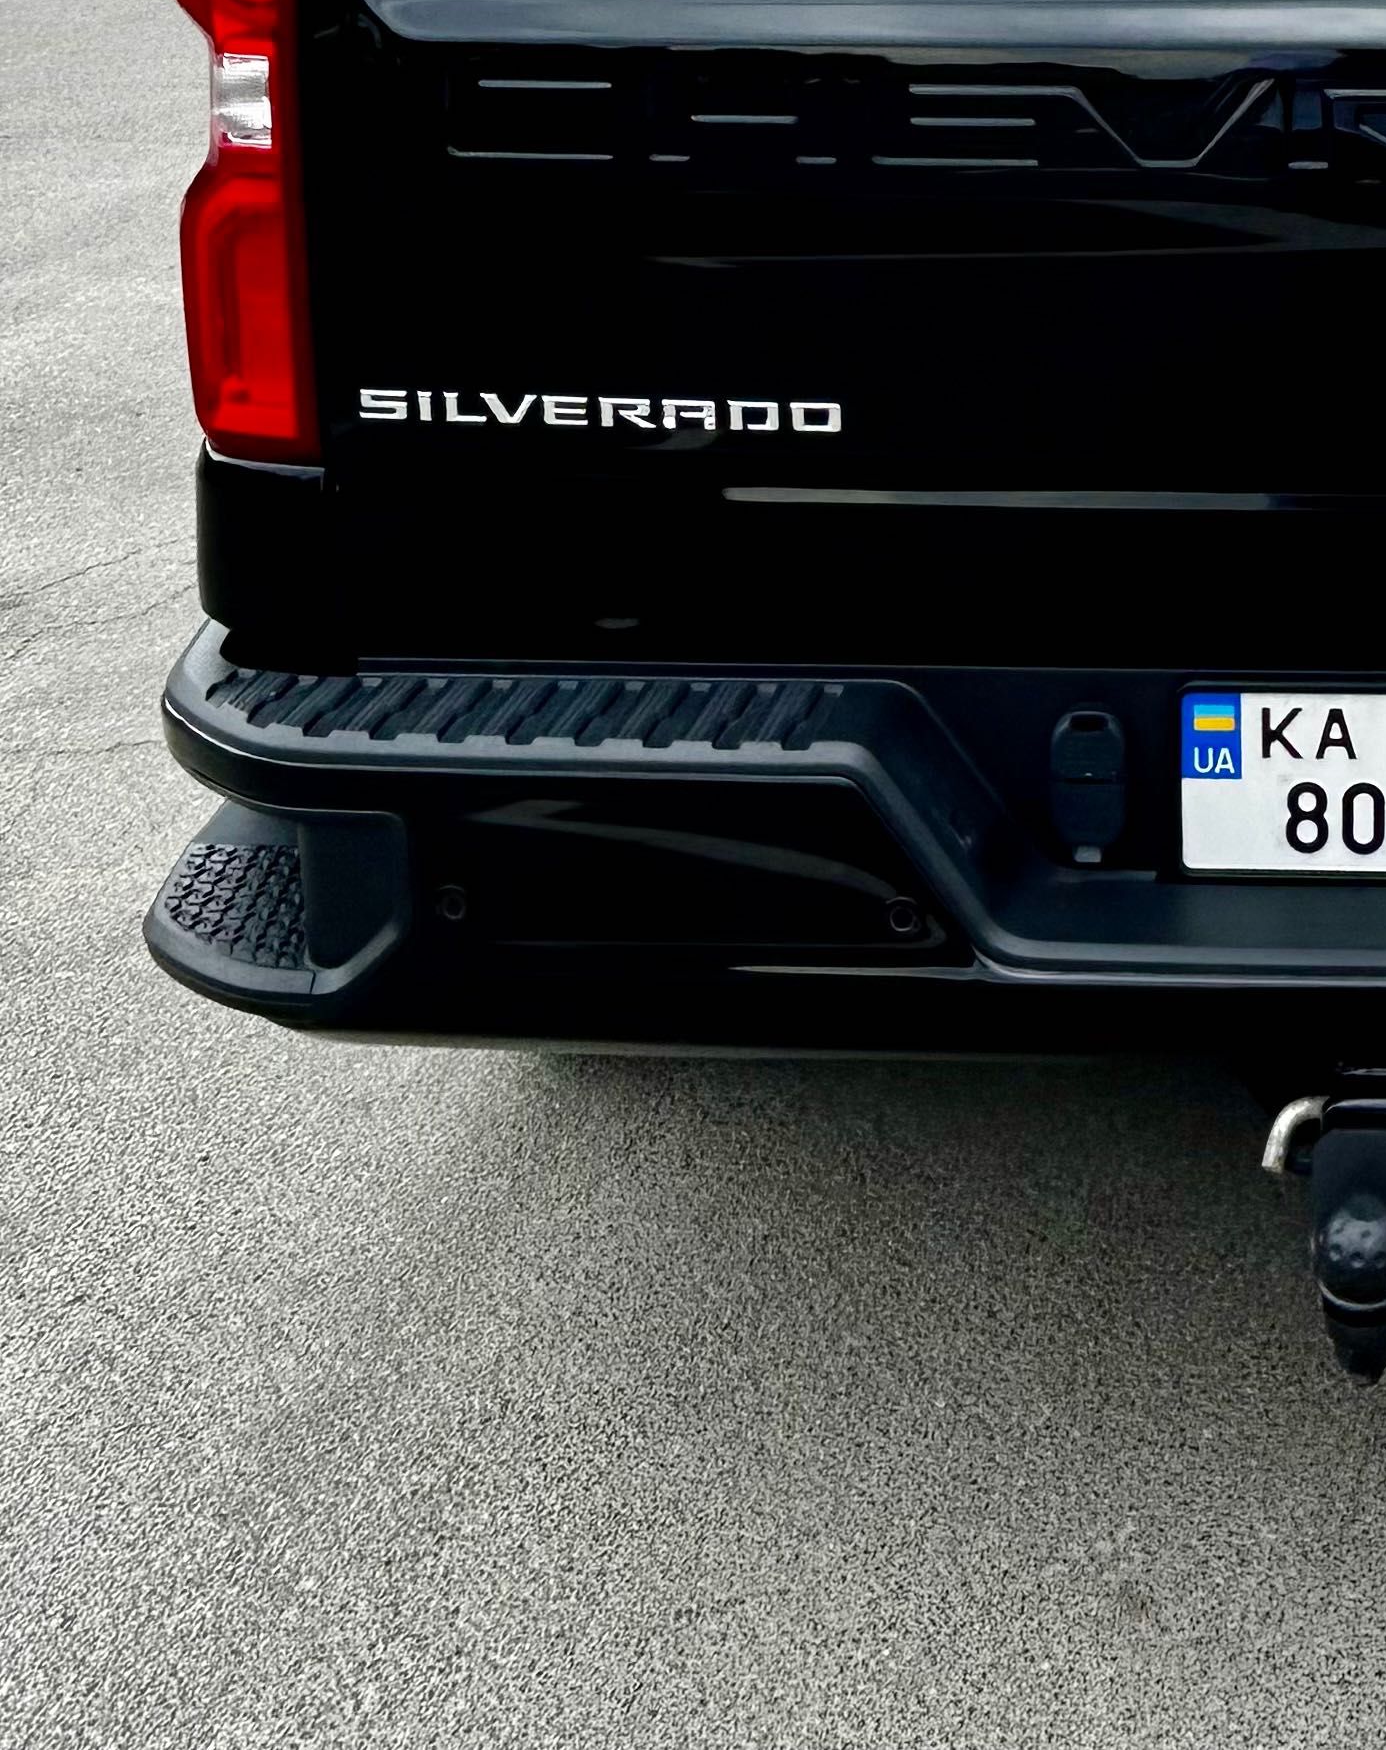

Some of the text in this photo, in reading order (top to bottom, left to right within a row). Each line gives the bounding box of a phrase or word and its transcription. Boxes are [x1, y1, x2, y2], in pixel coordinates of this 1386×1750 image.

[359, 388, 842, 432] SILVERADO
[1260, 707, 1358, 760] KA
[1193, 746, 1235, 775] UA
